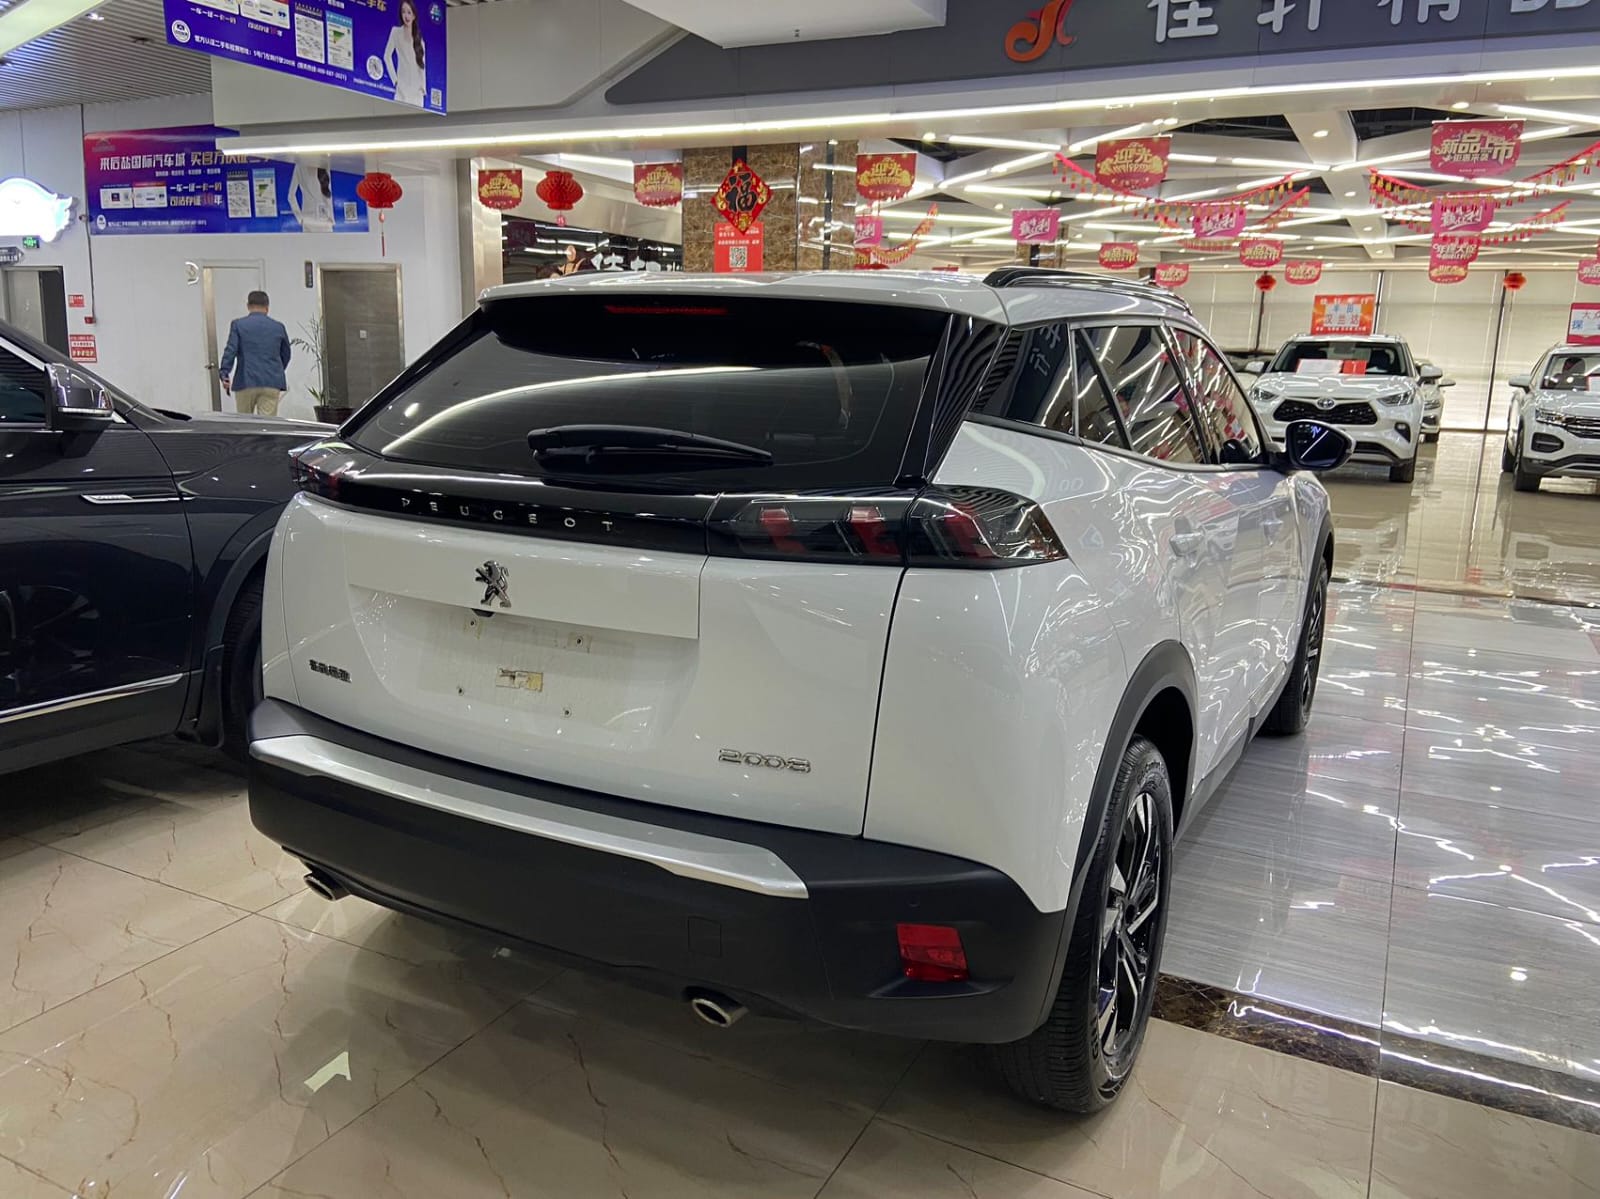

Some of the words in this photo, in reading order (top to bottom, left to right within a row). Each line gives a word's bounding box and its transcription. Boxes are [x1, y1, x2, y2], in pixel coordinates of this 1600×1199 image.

[725, 171, 758, 212] 福
[400, 497, 614, 532] PEUGEOT
[718, 747, 811, 774] 2008
